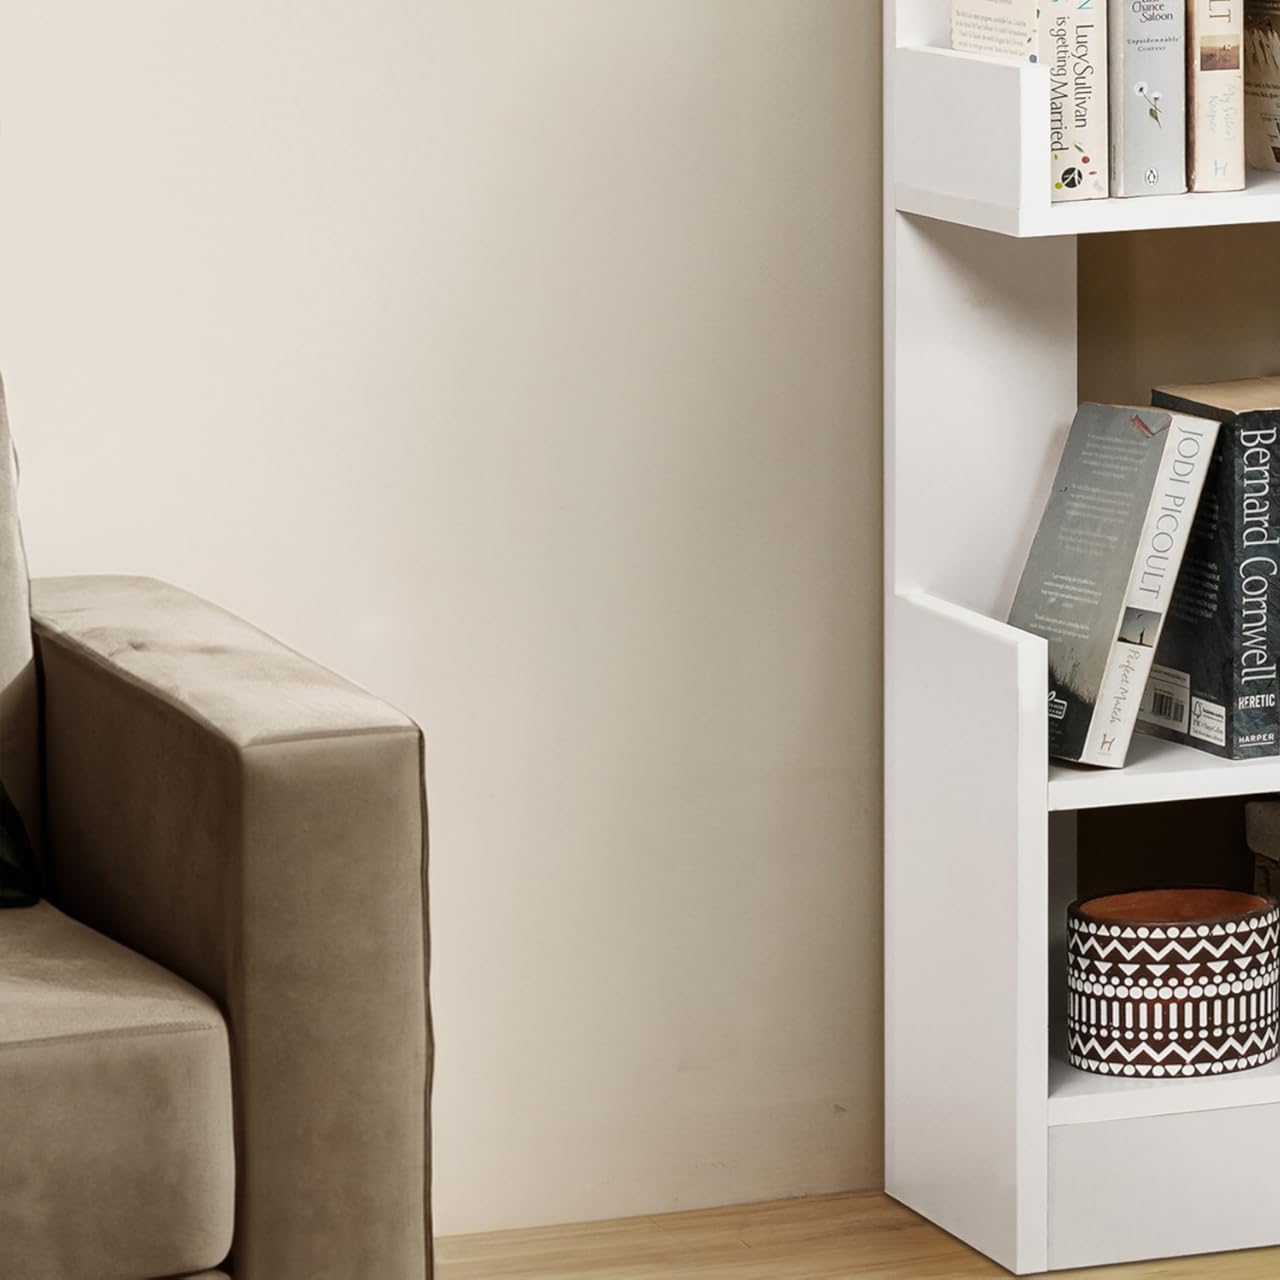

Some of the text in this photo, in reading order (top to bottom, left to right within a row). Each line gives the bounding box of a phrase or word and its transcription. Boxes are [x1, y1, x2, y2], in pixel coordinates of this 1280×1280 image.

[1131, 1, 1165, 14] Chance
[1139, 12, 1174, 24] Saloon
[1050, 16, 1071, 152] is getting Married
[1071, 24, 1094, 128] Lucy Sullivan
[1139, 426, 1203, 599] JODI PICOULT
[1239, 427, 1280, 685] Bernard Cornwell
[1109, 647, 1142, 724] Perfect Match
[1238, 693, 1276, 710] HERETIC
[1239, 733, 1275, 744] HARPER
